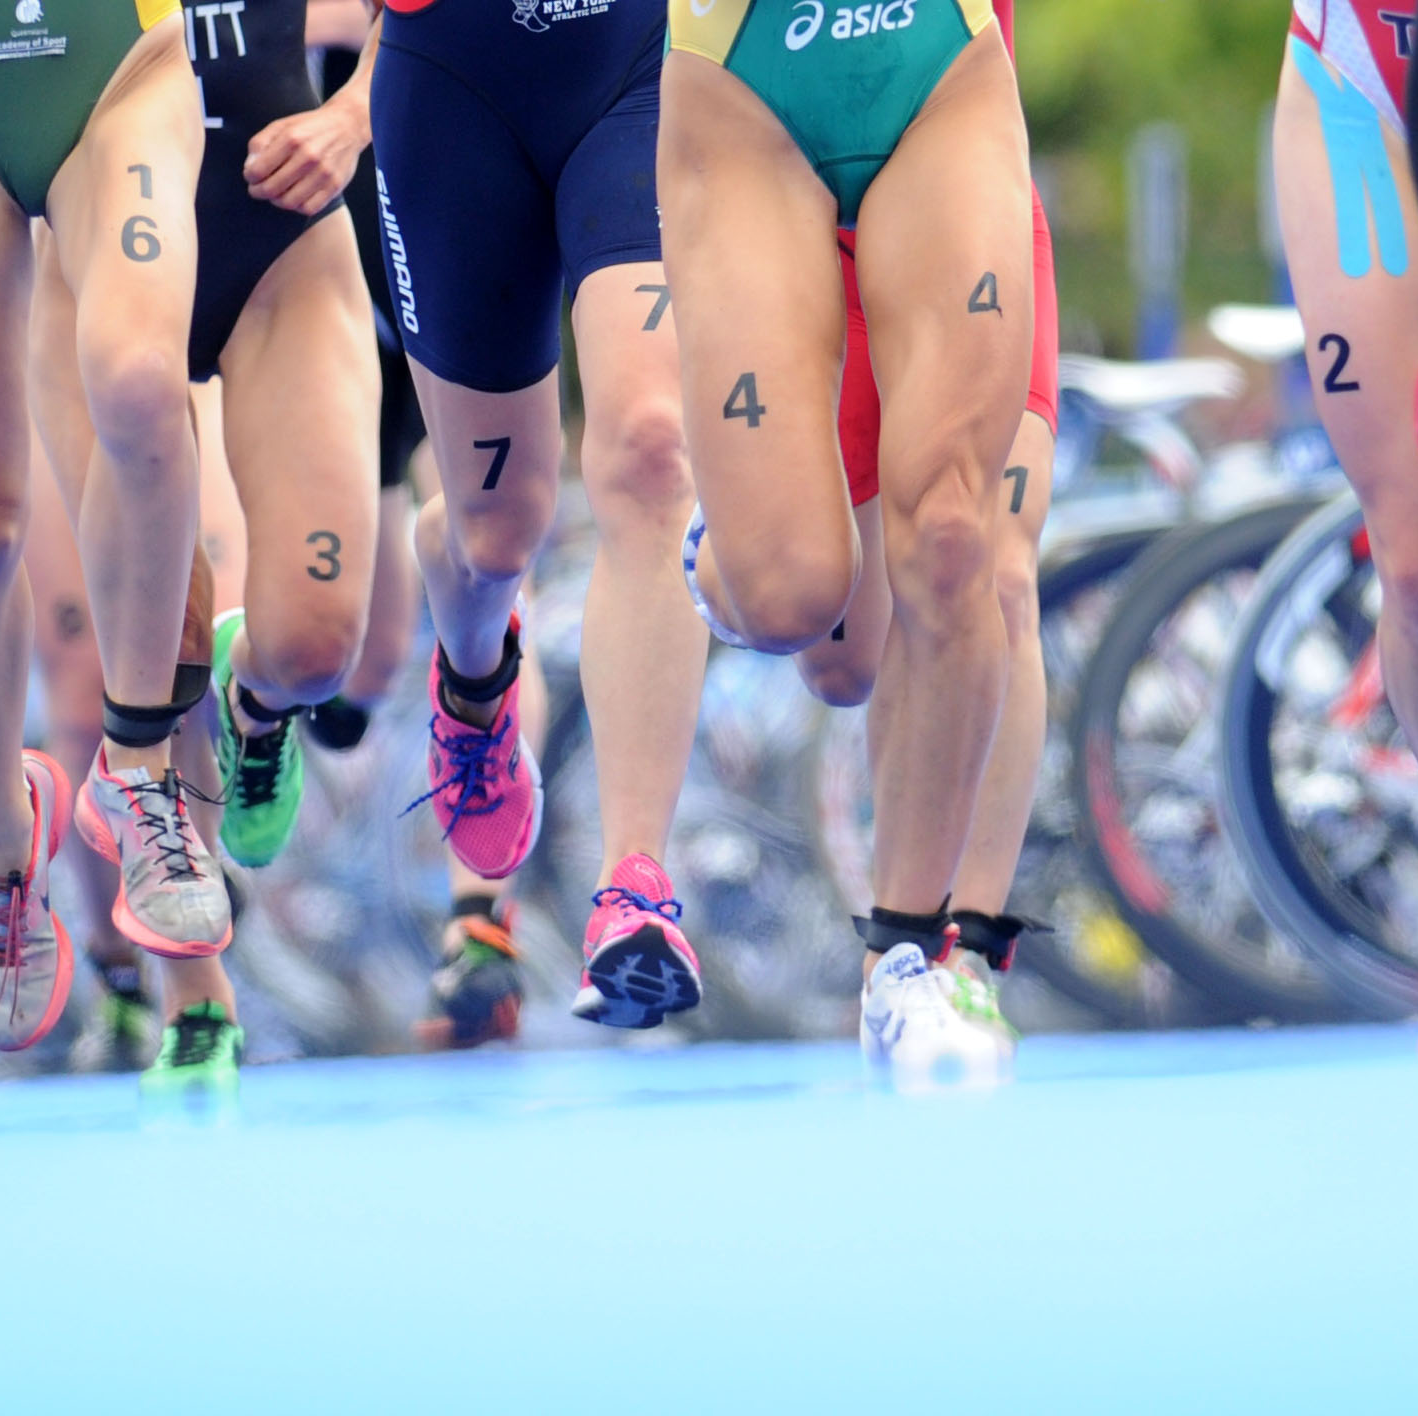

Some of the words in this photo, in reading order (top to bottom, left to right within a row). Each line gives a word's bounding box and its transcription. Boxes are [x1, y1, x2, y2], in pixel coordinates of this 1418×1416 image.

[32, 39, 42, 48] of
[43, 36, 67, 49] Sport
[635, 285, 671, 331] 7
[969, 271, 1003, 318] 4
[1319, 333, 1360, 393] 2
[723, 372, 766, 428] 4
[474, 437, 511, 490] 7
[1004, 465, 1028, 514] 1
[306, 530, 341, 581] 3
